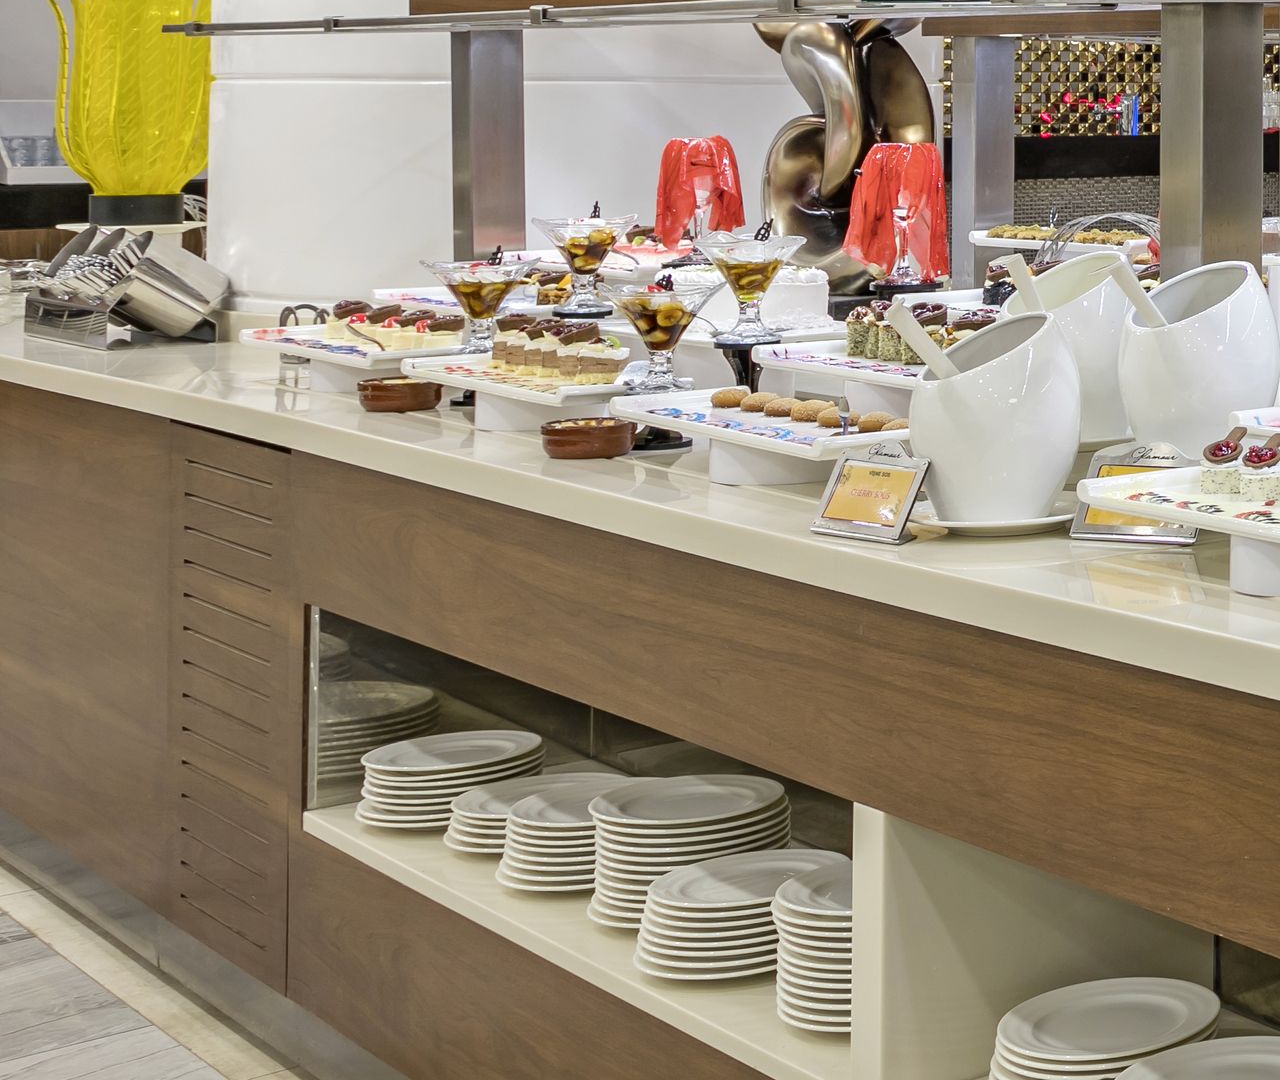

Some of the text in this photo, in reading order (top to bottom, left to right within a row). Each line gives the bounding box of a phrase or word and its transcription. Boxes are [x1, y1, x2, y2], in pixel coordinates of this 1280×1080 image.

[868, 443, 902, 460] Glamour
[1132, 446, 1178, 463] Glamour
[851, 489, 873, 497] CHERRY
